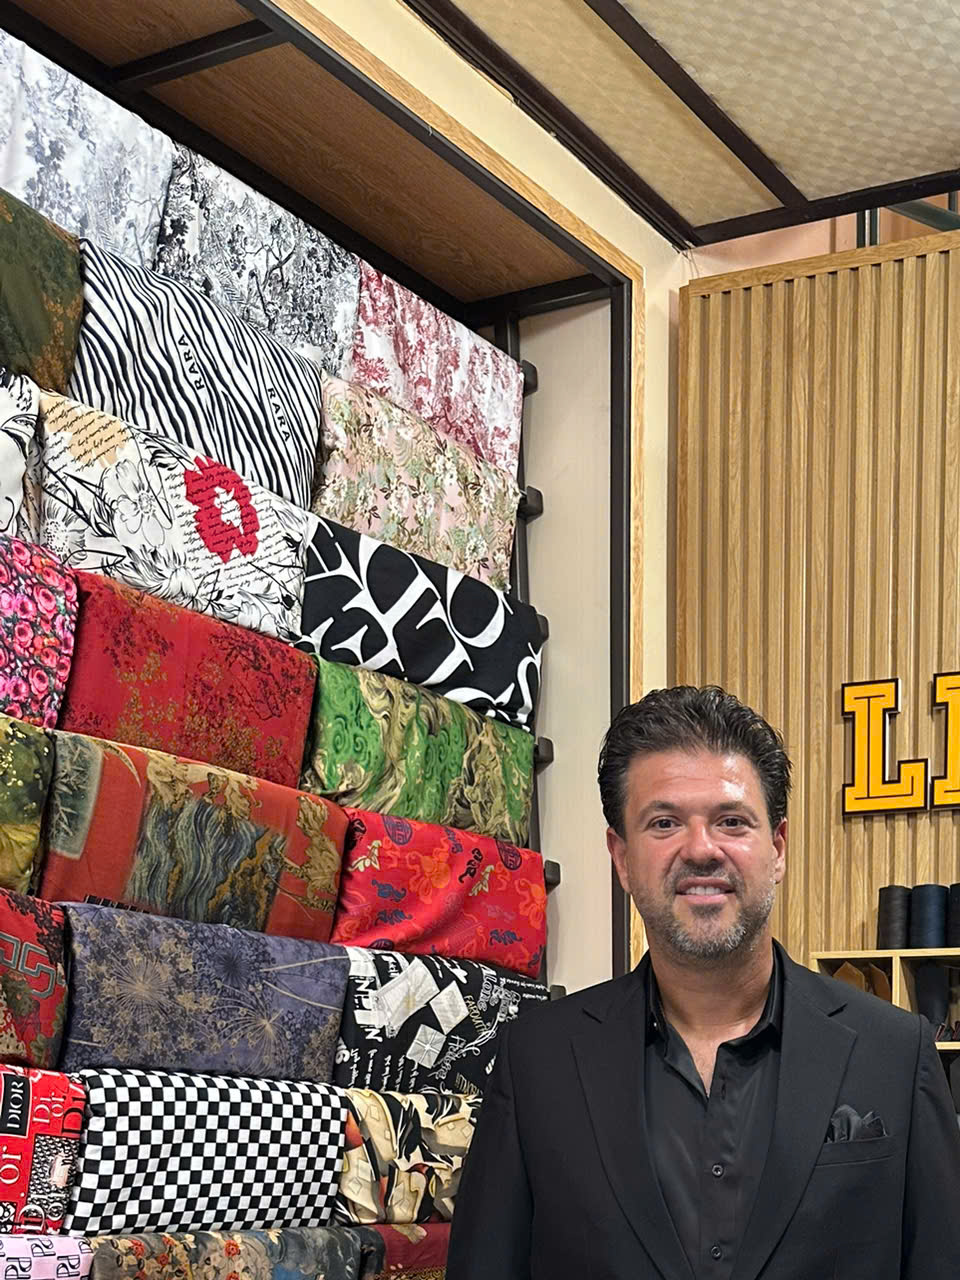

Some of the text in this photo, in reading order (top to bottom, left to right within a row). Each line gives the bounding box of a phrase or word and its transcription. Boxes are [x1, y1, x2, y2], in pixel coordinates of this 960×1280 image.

[178, 334, 205, 390] RARA
[267, 387, 291, 442] RARA
[7, 1081, 24, 1129] DIOR
